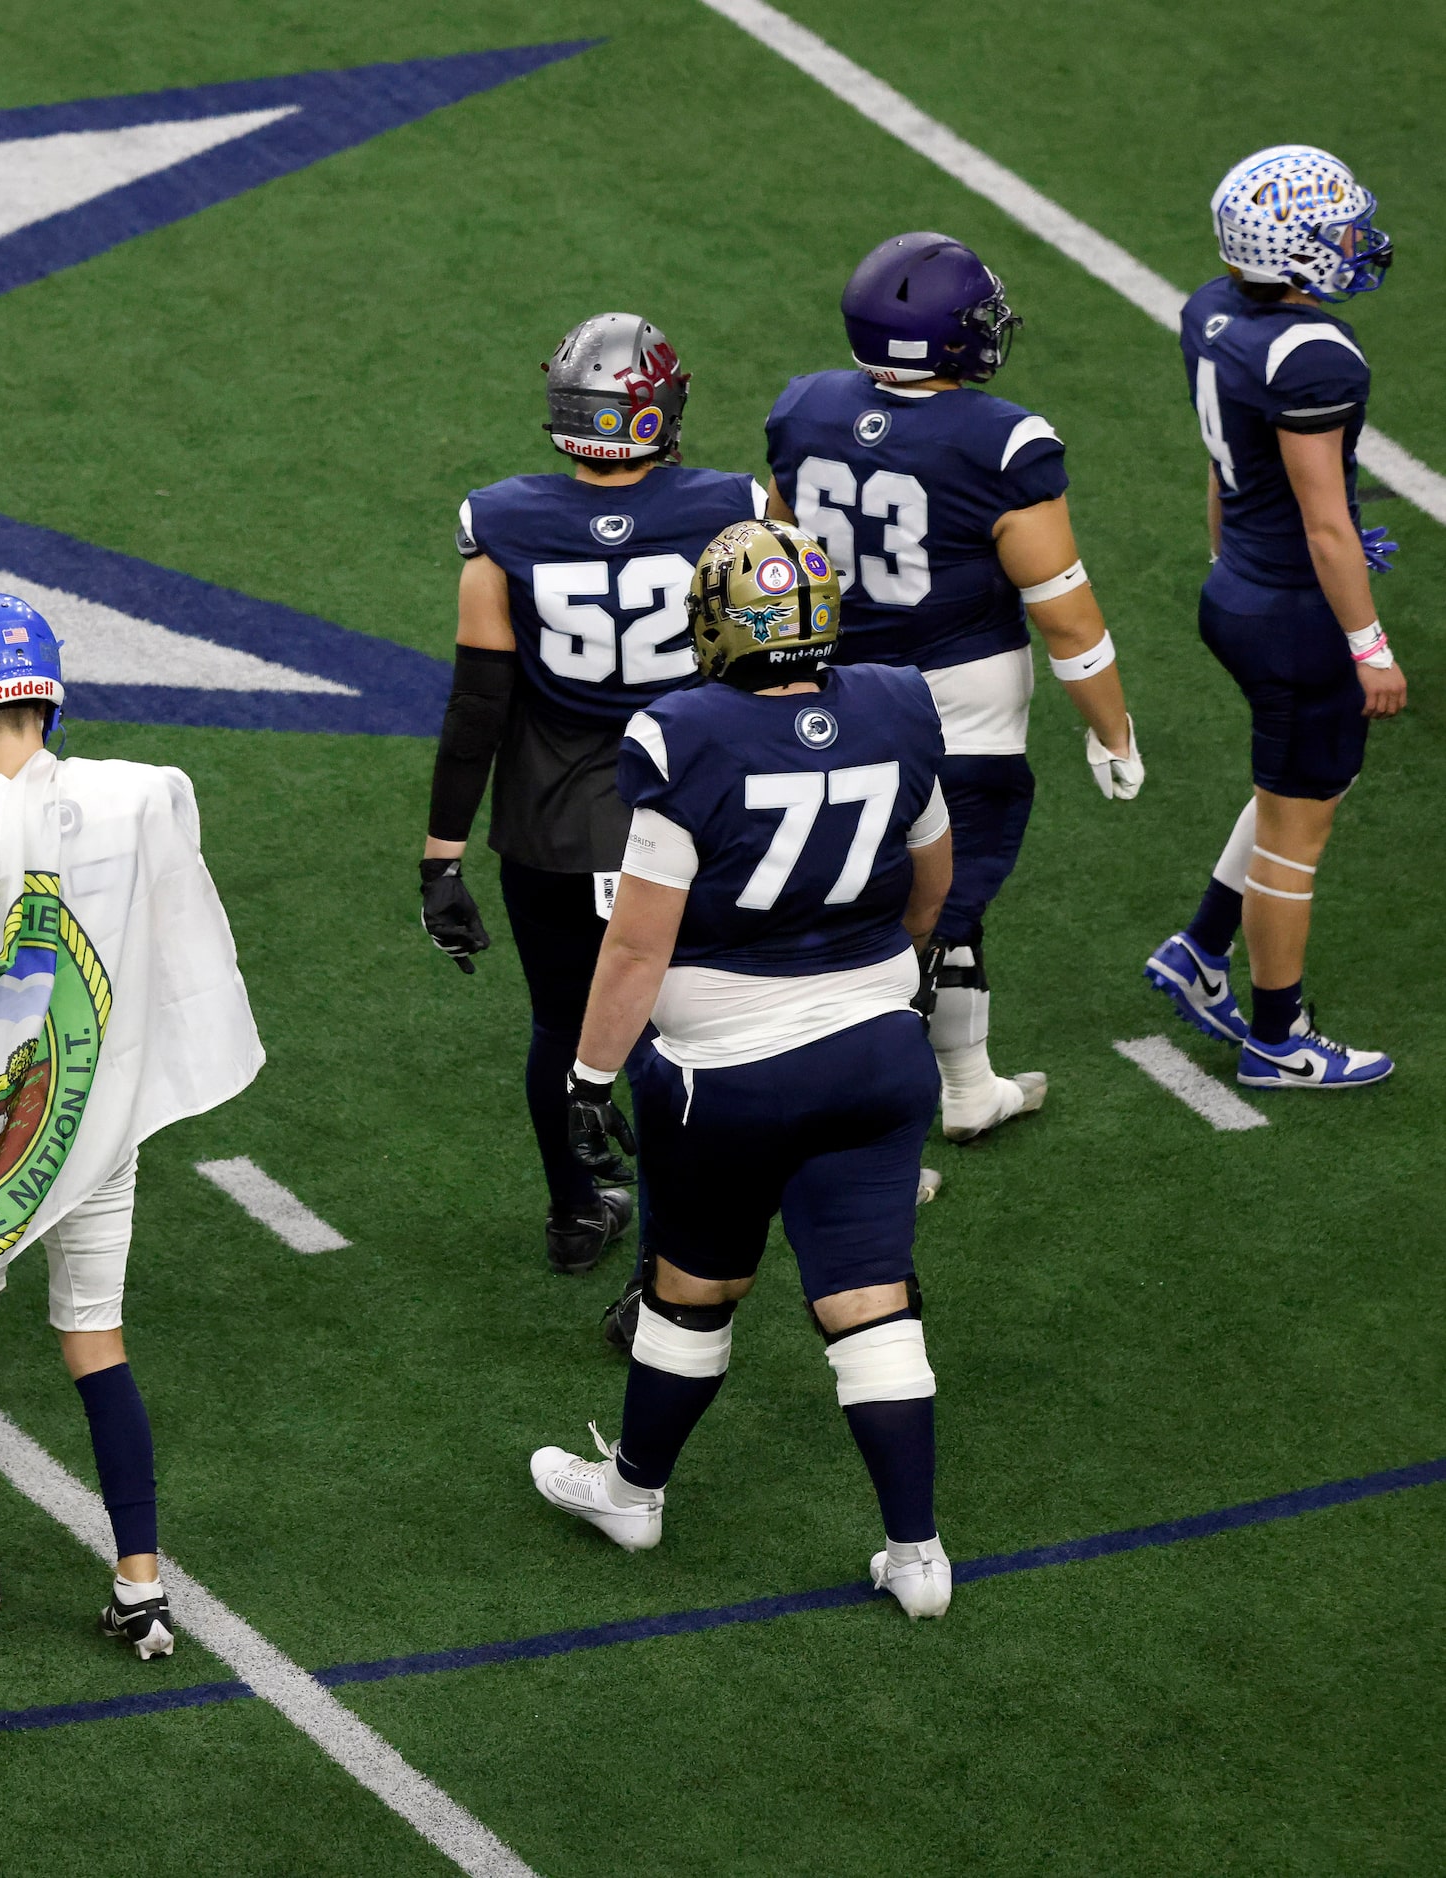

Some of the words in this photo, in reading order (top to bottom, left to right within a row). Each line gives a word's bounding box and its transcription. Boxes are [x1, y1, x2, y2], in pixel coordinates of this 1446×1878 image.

[564, 439, 631, 458] Riddell
[701, 557, 735, 626] H
[794, 456, 932, 607] 63
[532, 553, 699, 685] 52
[735, 760, 900, 911] 77
[21, 903, 58, 934] HE
[7, 1087, 86, 1211] NATION
[64, 1028, 92, 1074] I.T.
